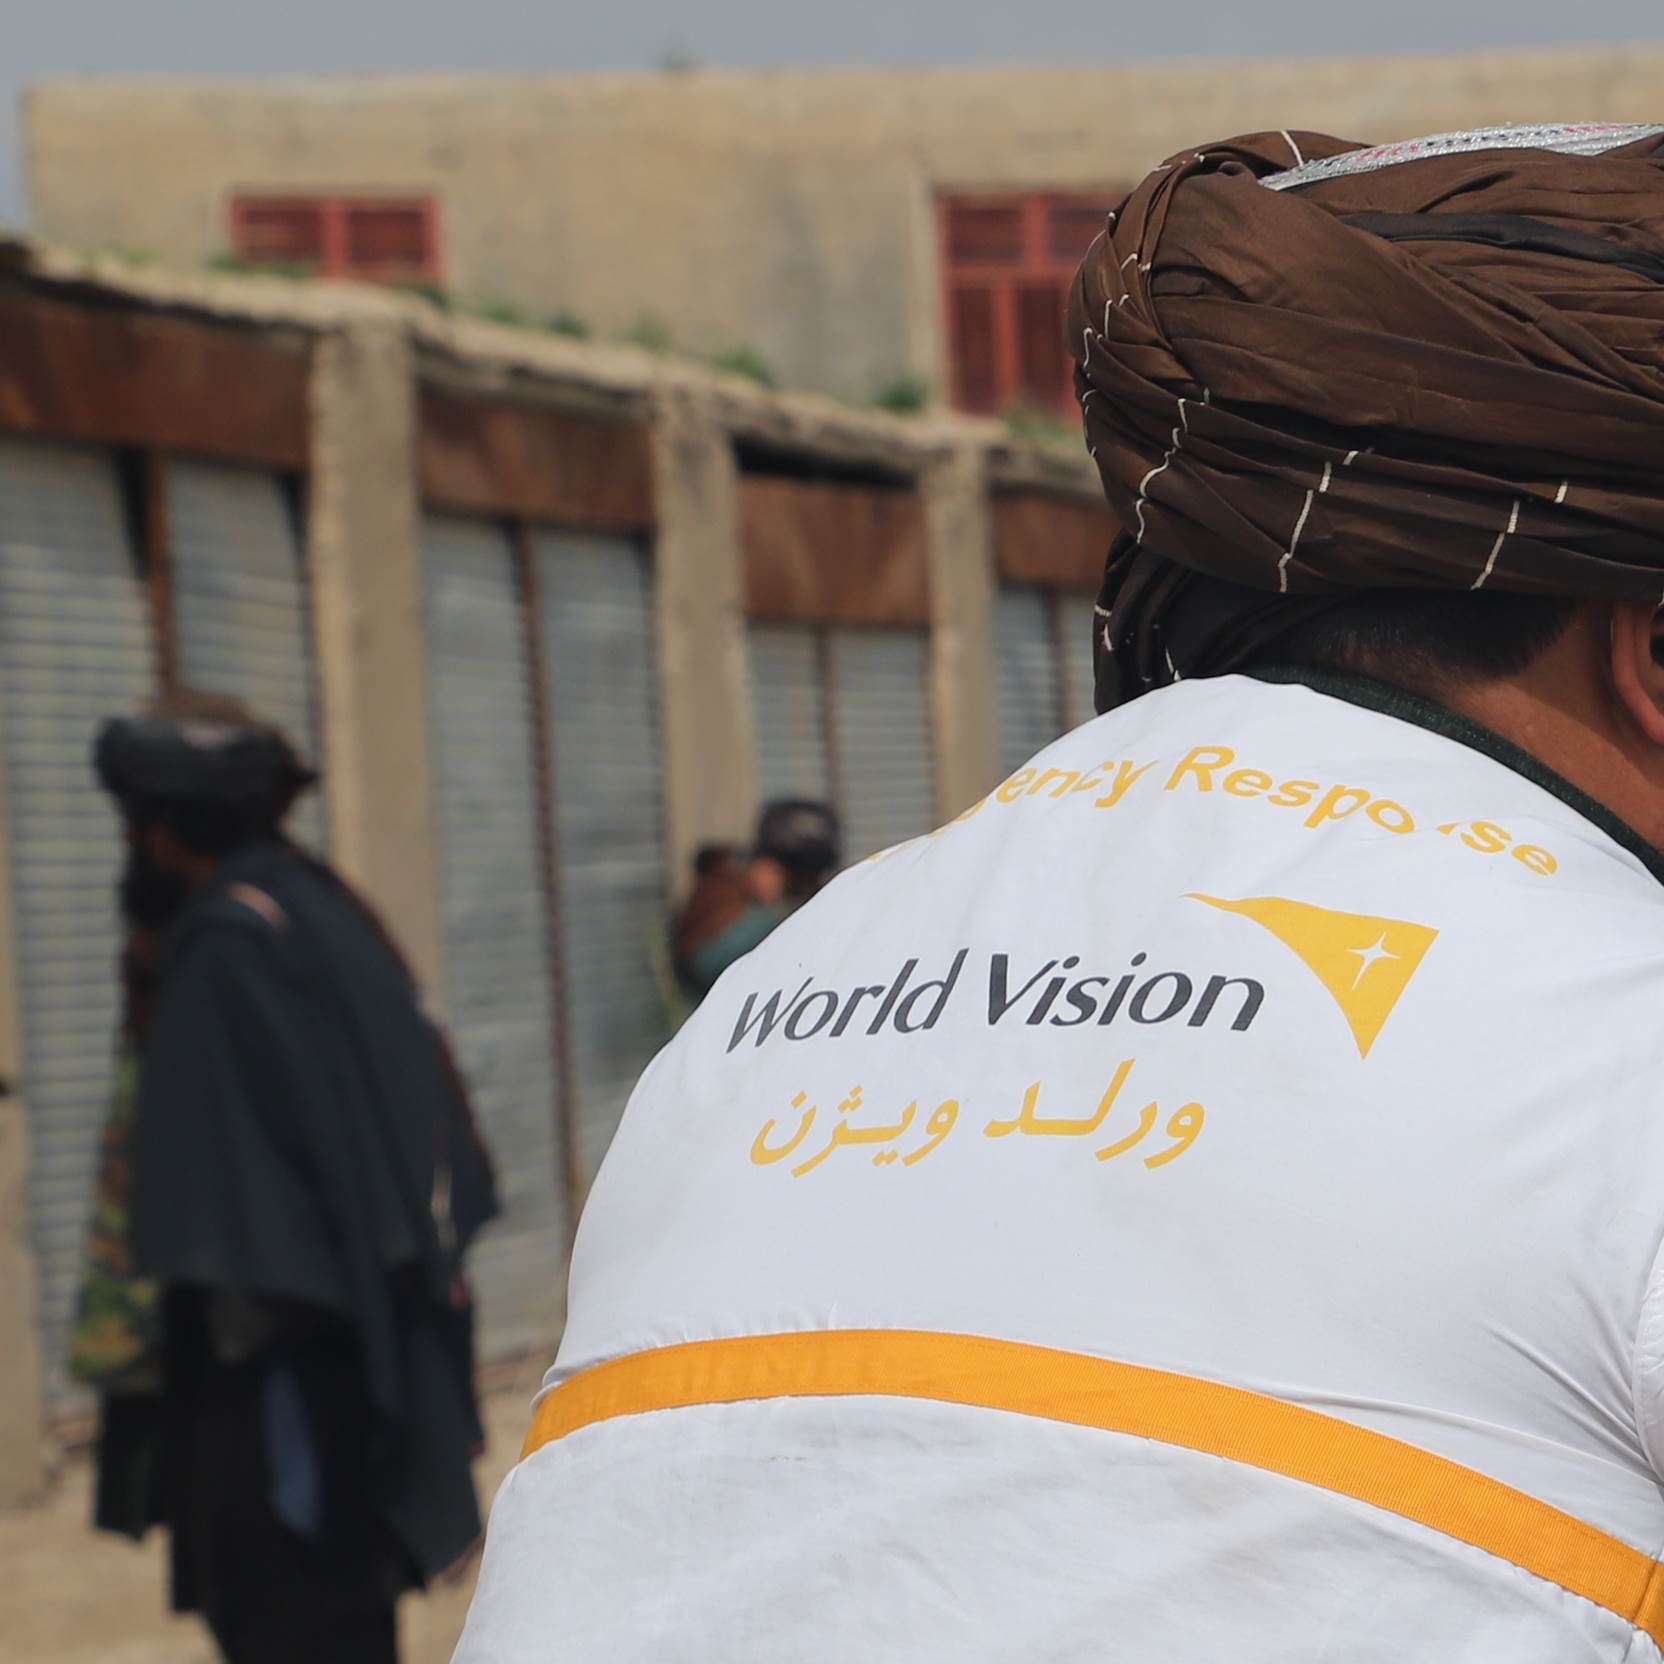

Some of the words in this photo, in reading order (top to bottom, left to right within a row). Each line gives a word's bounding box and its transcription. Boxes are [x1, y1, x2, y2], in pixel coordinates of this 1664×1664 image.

[1163, 745, 1559, 876] Respose
[726, 948, 970, 1053] World
[987, 951, 1266, 1034] Vision
[984, 1058, 1206, 1170] ورلد
